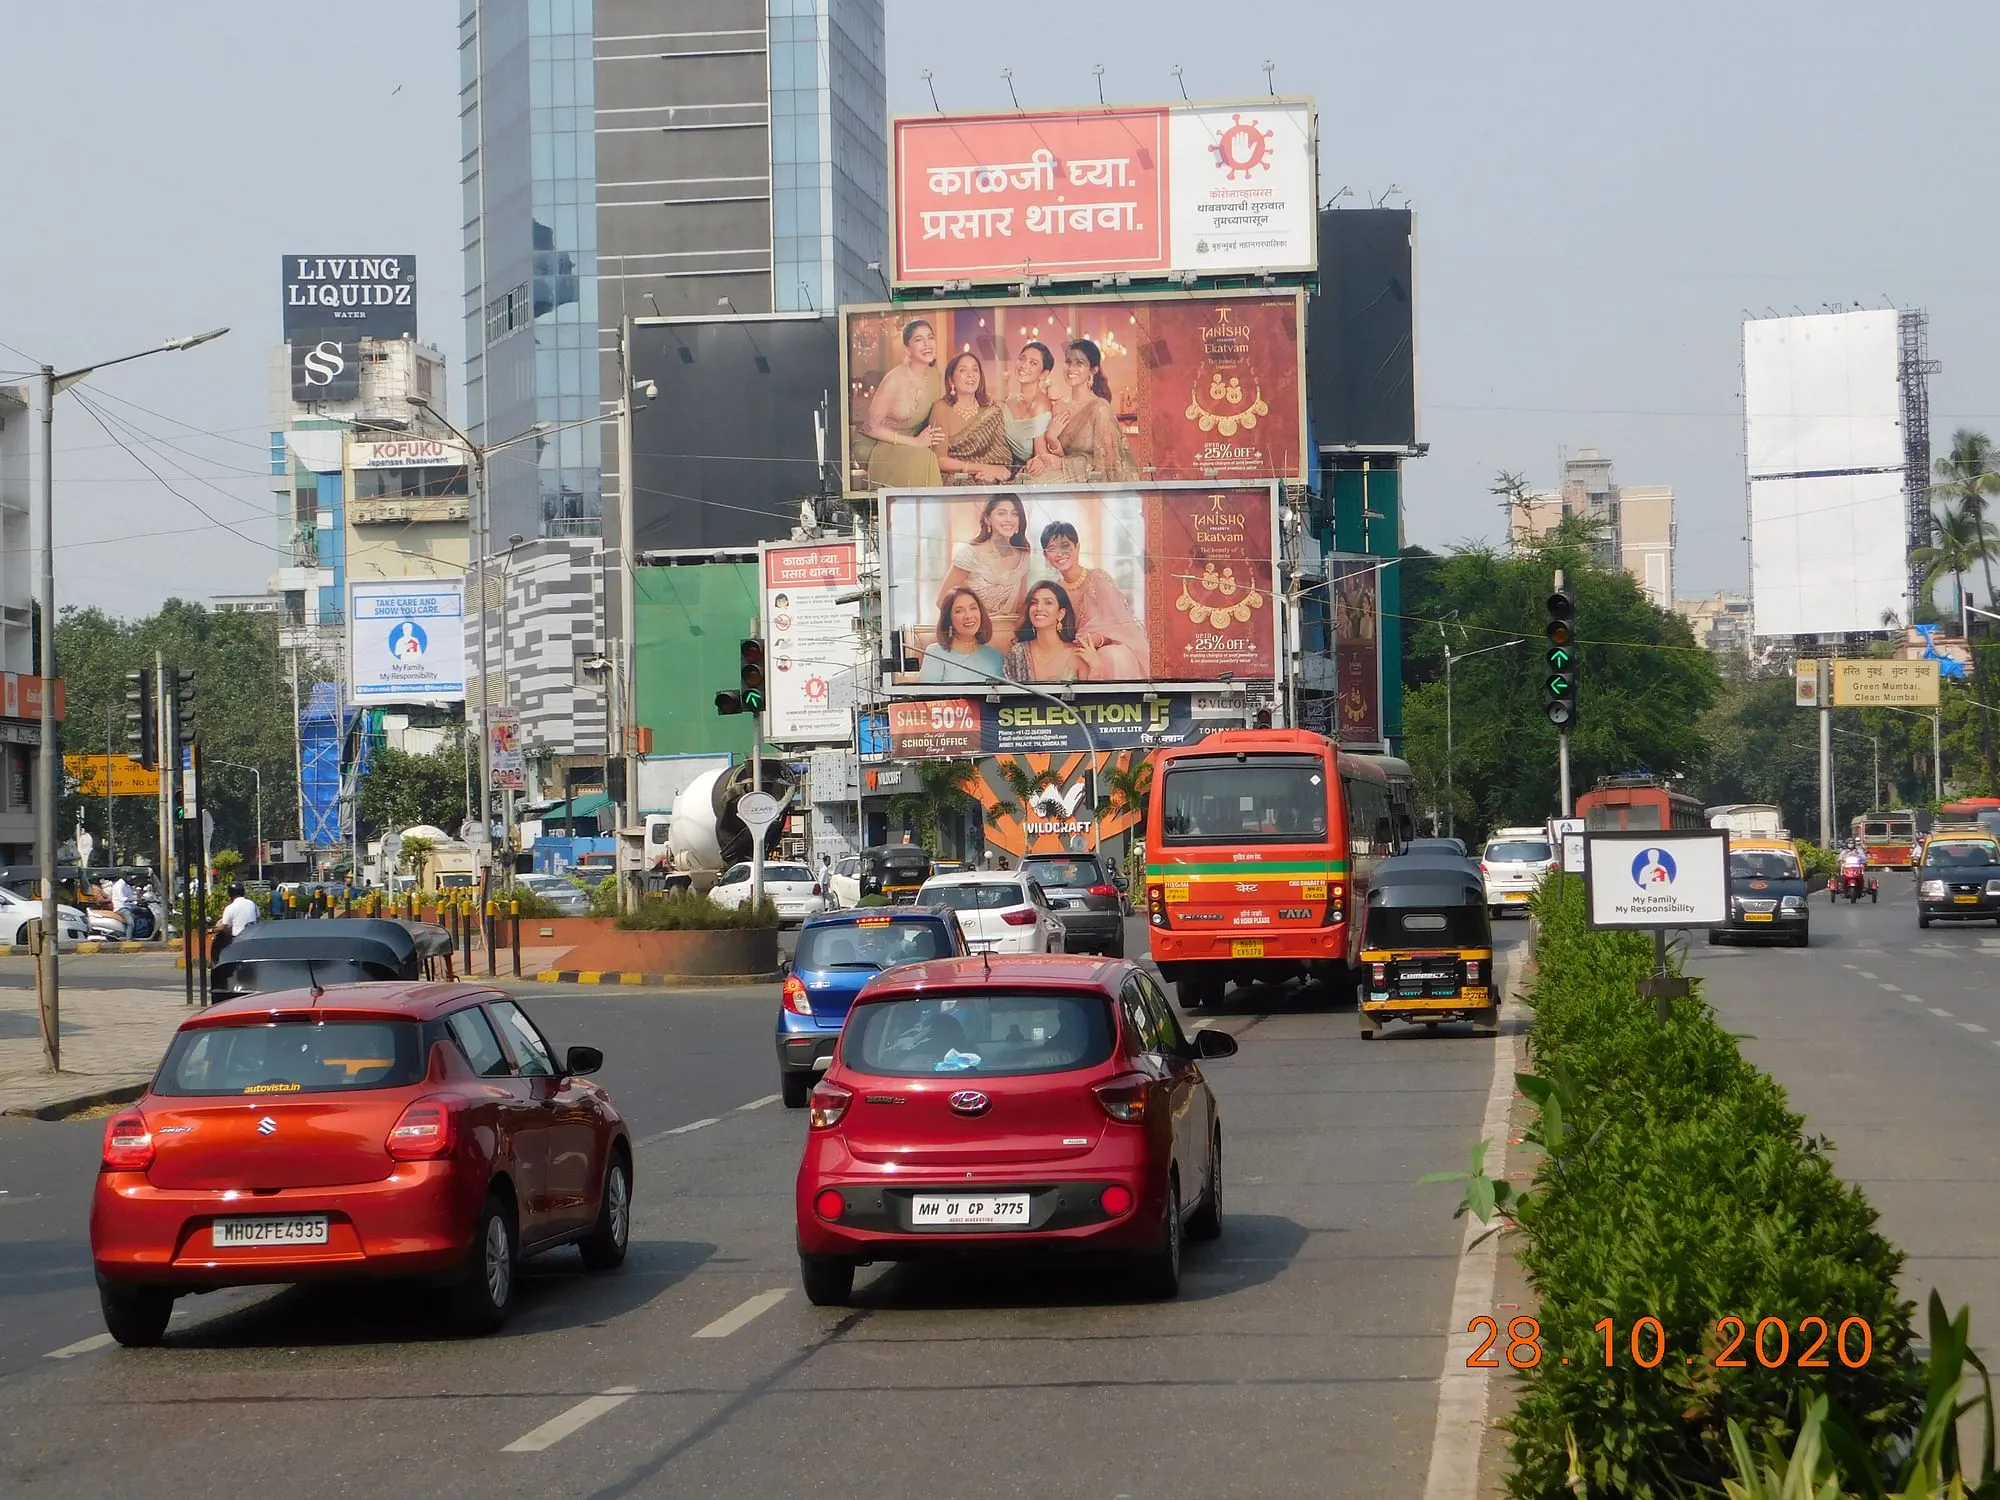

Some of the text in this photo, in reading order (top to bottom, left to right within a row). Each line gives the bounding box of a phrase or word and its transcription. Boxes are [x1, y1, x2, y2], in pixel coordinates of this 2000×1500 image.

[926, 148, 1136, 195] काळजी घ्या.
[920, 195, 1144, 241] प्रसार थांबवा.
[297, 258, 401, 280] LIVING
[288, 284, 411, 307] LIQUIDZ
[333, 311, 367, 319] WATER
[1204, 343, 1249, 354] Ekatvam
[372, 442, 443, 458] KOFUKU
[1204, 443, 1233, 459] 25%
[1197, 531, 1244, 543] Ekatvam
[782, 552, 817, 566] काळजी
[781, 568, 807, 580] प्रसार
[375, 597, 437, 607] TAKE CARE AND
[374, 607, 399, 616] SHOW
[401, 606, 416, 615] YOU
[1195, 635, 1225, 650] 25%
[392, 663, 425, 672] My Family
[380, 671, 438, 681] My Responsibility
[1852, 682, 1880, 691] Green
[1854, 693, 1919, 701] Clean Mumbai
[896, 705, 974, 730] SALE 50%
[901, 738, 935, 748] SCHOOL
[940, 737, 968, 746] OFFICE
[132, 779, 145, 787] No
[1022, 821, 1092, 835] WILDCRAFT
[1632, 895, 1678, 905] My Family
[1279, 909, 1312, 918] TATA
[1615, 904, 1695, 914] My Responsibility
[243, 1083, 301, 1094] autovista.in
[918, 1202, 1024, 1216] MH 01 CP 3775
[224, 1219, 325, 1242] MH02FE4935
